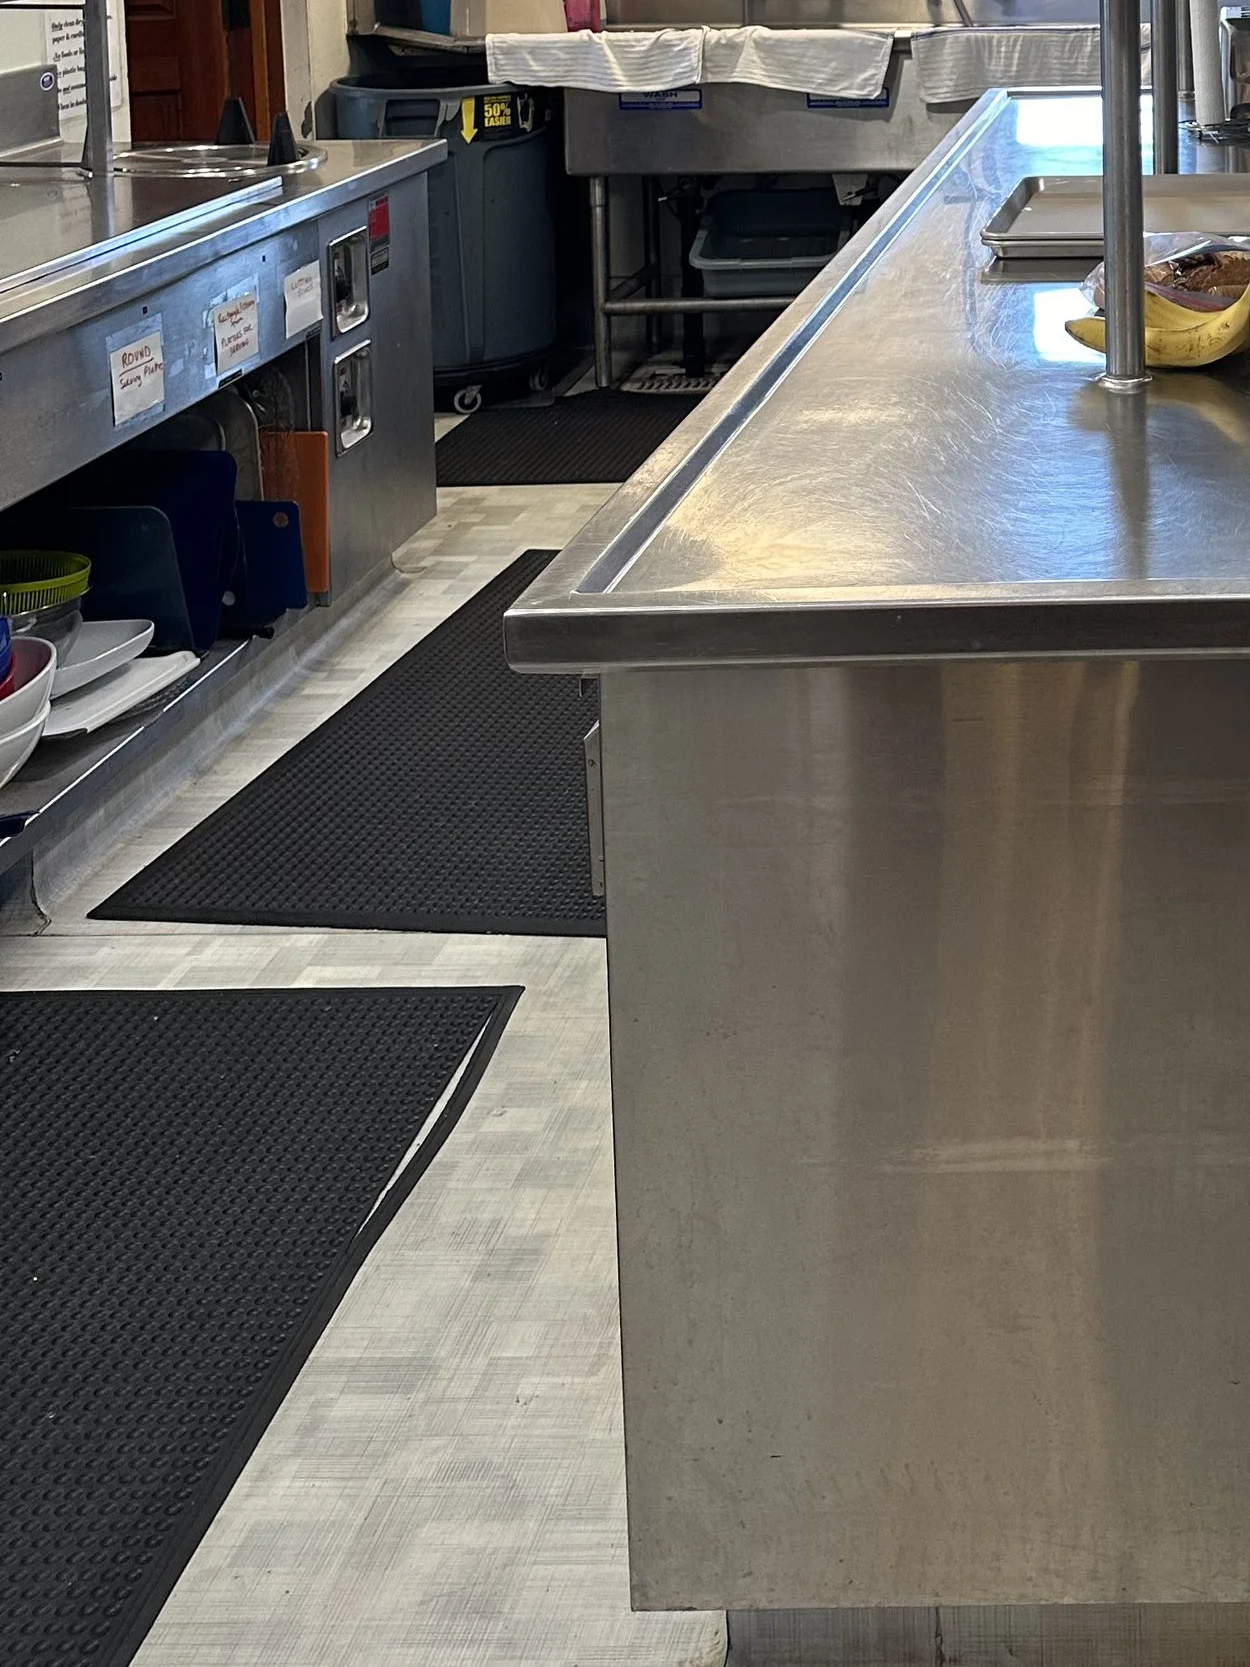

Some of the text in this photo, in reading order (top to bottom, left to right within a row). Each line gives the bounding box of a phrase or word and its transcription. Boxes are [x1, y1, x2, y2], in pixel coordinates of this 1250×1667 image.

[484, 102, 511, 117] 50%
[484, 116, 511, 127] EASIER
[122, 345, 151, 368] ROUND
